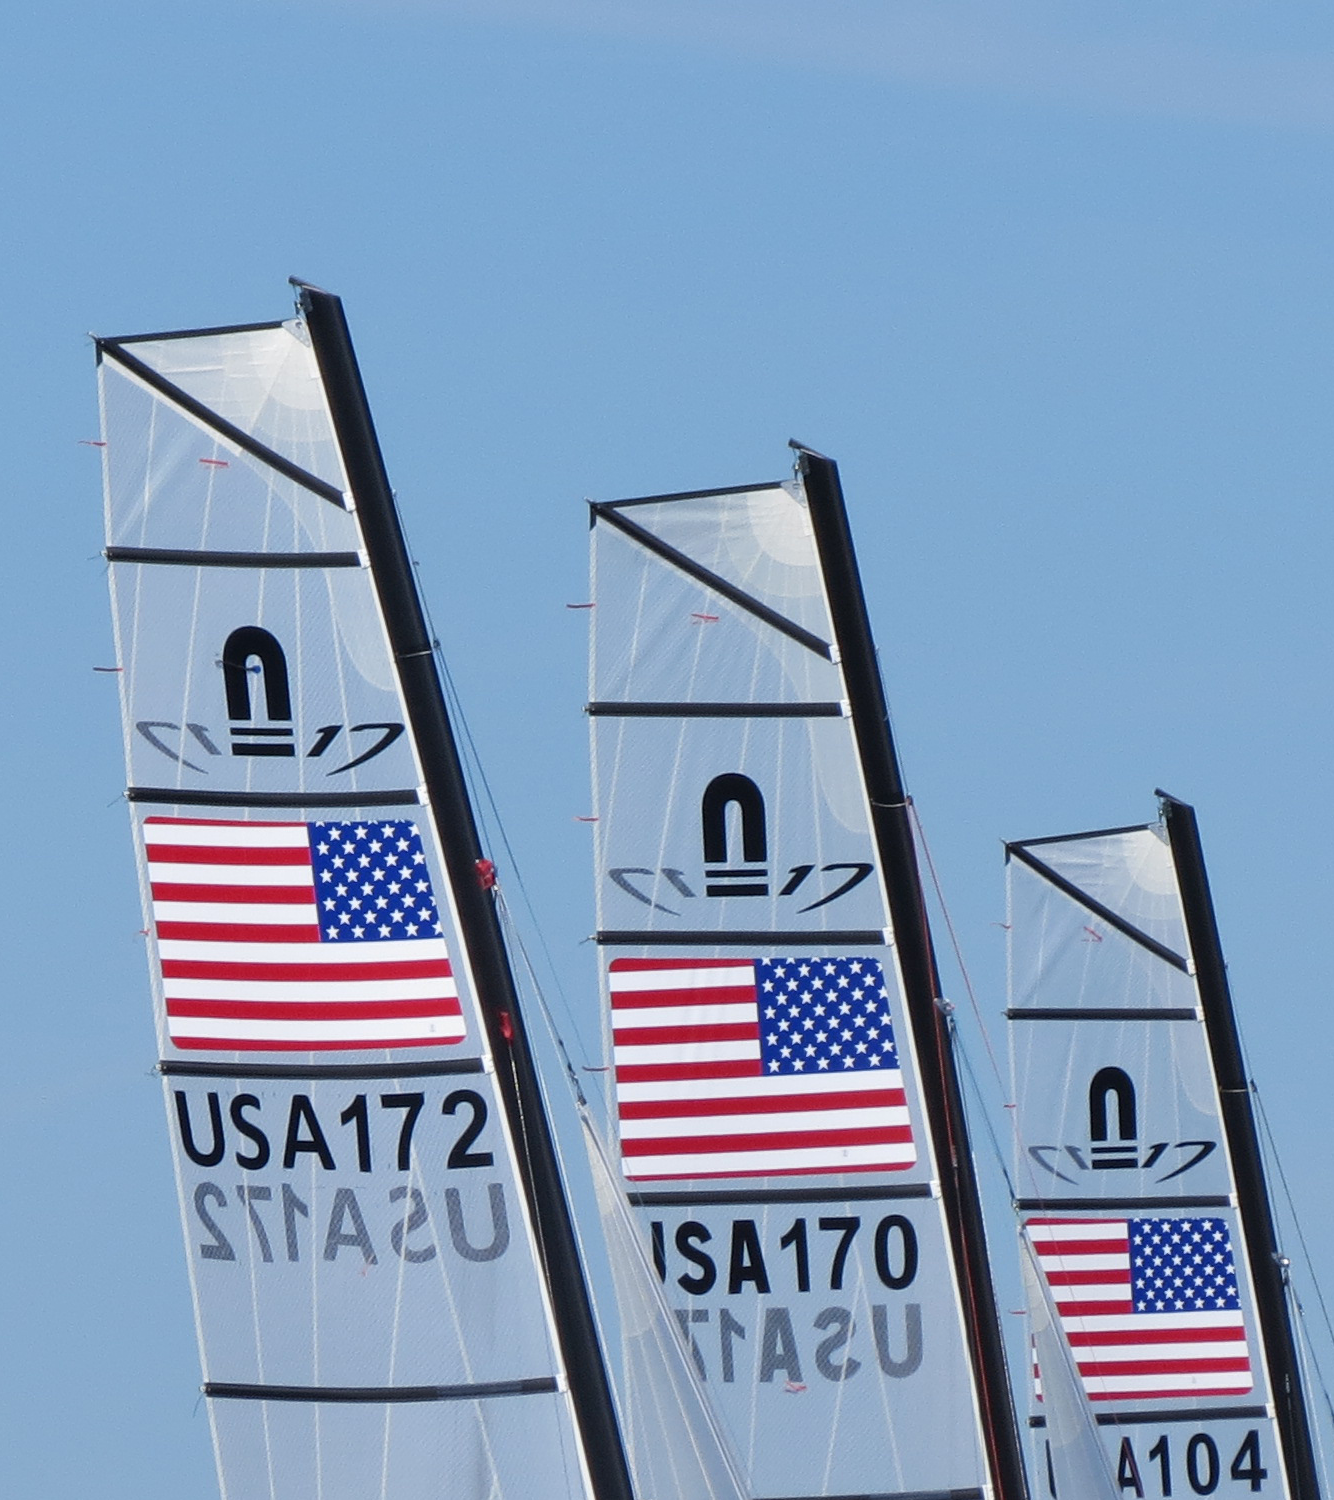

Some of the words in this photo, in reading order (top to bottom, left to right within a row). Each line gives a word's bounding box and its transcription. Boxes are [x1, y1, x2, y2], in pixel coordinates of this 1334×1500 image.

[306, 722, 405, 776] 17
[778, 862, 874, 914] 17
[174, 1089, 494, 1172] USA172
[1141, 1141, 1217, 1184] 17
[1045, 1430, 1268, 1500] A104
